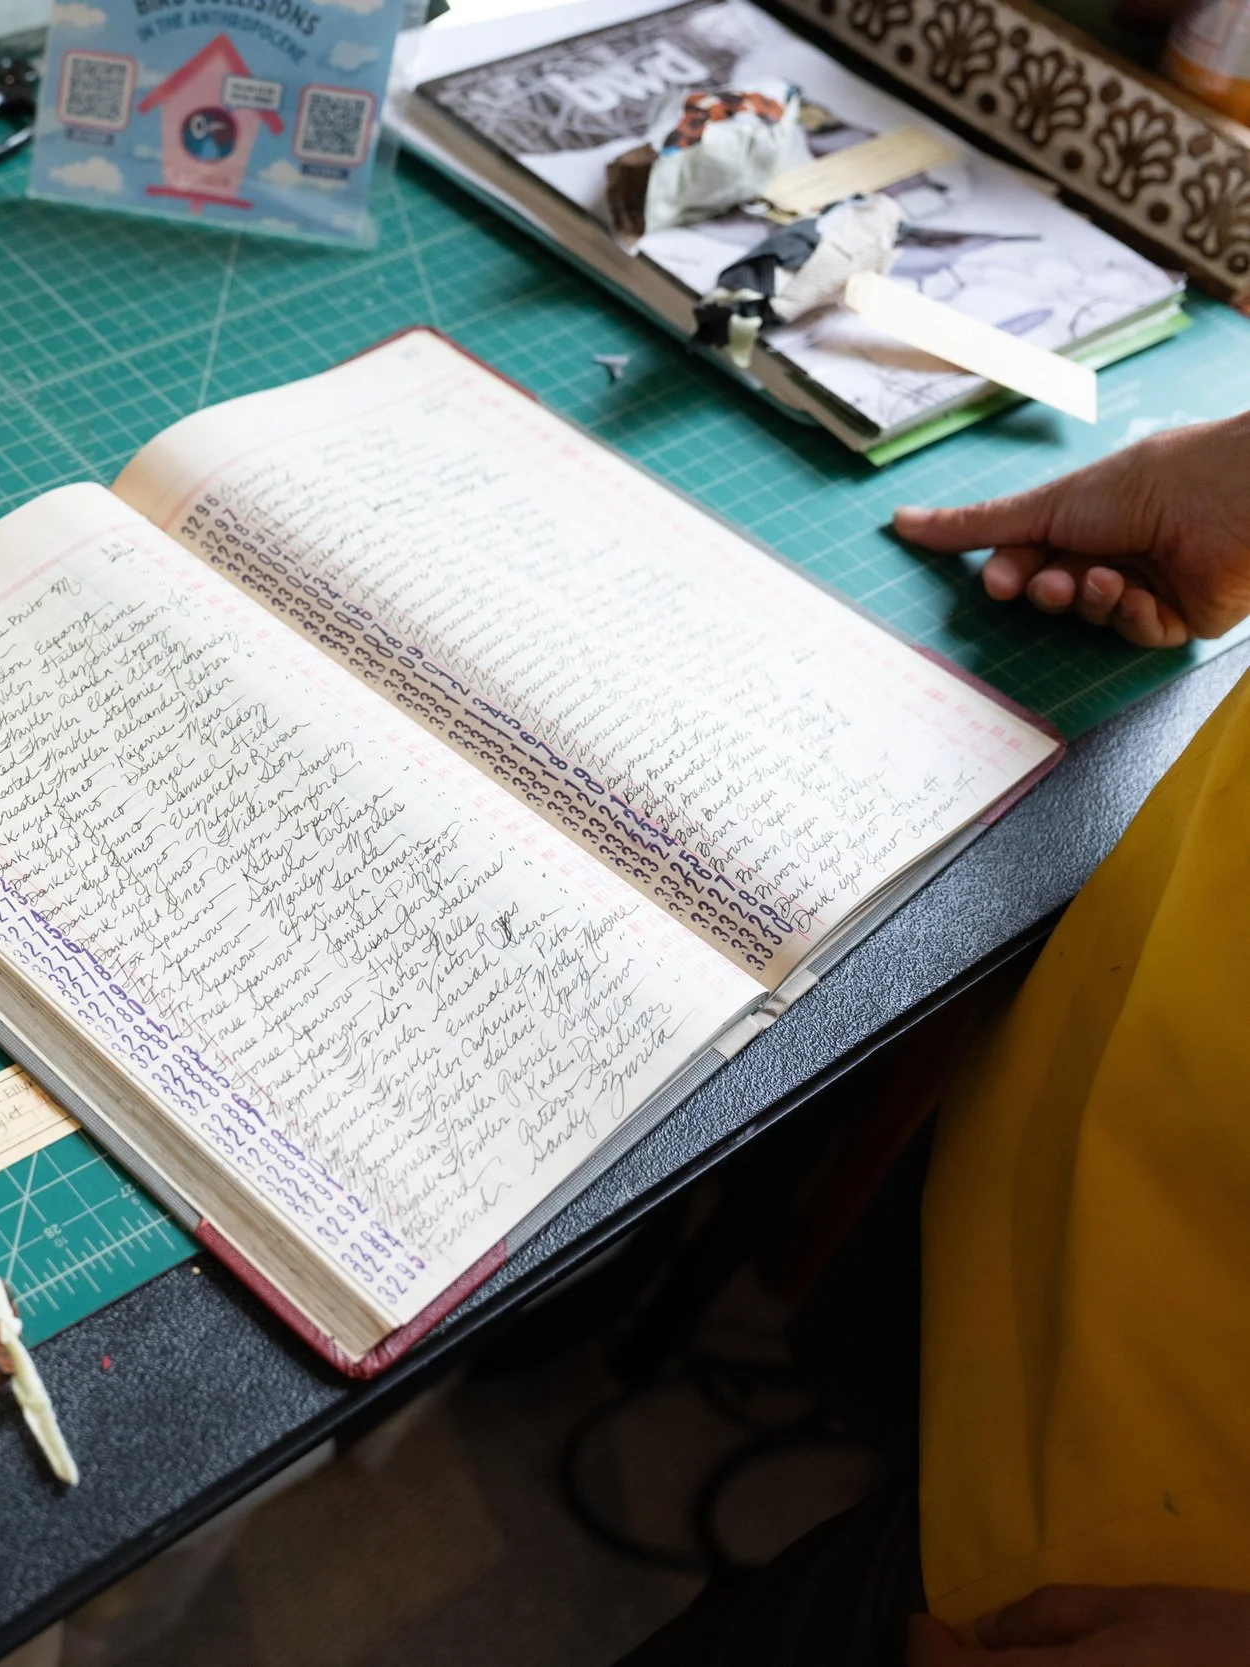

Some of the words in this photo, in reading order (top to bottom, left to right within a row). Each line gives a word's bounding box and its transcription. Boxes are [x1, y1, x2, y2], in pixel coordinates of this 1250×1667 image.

[114, 685, 188, 742] Alexander
[175, 677, 234, 723] Walker
[135, 753, 209, 798] Angel
[148, 754, 235, 813] Samuel
[231, 714, 279, 754] Hill
[295, 742, 354, 787] Sanchez
[161, 763, 248, 829] Elizabeth
[258, 754, 362, 831] Stanford
[695, 820, 738, 858] Brown
[139, 982, 176, 1011] Fox
[262, 858, 350, 926] Marilyn
[336, 803, 405, 861] Morales
[439, 852, 503, 919] Salinas
[691, 875, 735, 928] 3327
[735, 845, 781, 885] Brown
[78, 984, 129, 1025] 3279
[122, 967, 158, 996] Fox
[249, 851, 319, 908] Sandra
[100, 951, 145, 985] Fox
[240, 842, 305, 885] Kathy
[294, 886, 376, 941] Shayla
[711, 890, 758, 942] 3328
[13, 923, 67, 964] 3275
[417, 948, 474, 994] Victor
[371, 961, 434, 1003] Xavier
[524, 1107, 596, 1175] Sandy
[120, 1183, 135, 1199] 27
[43, 1223, 62, 1239] 28
